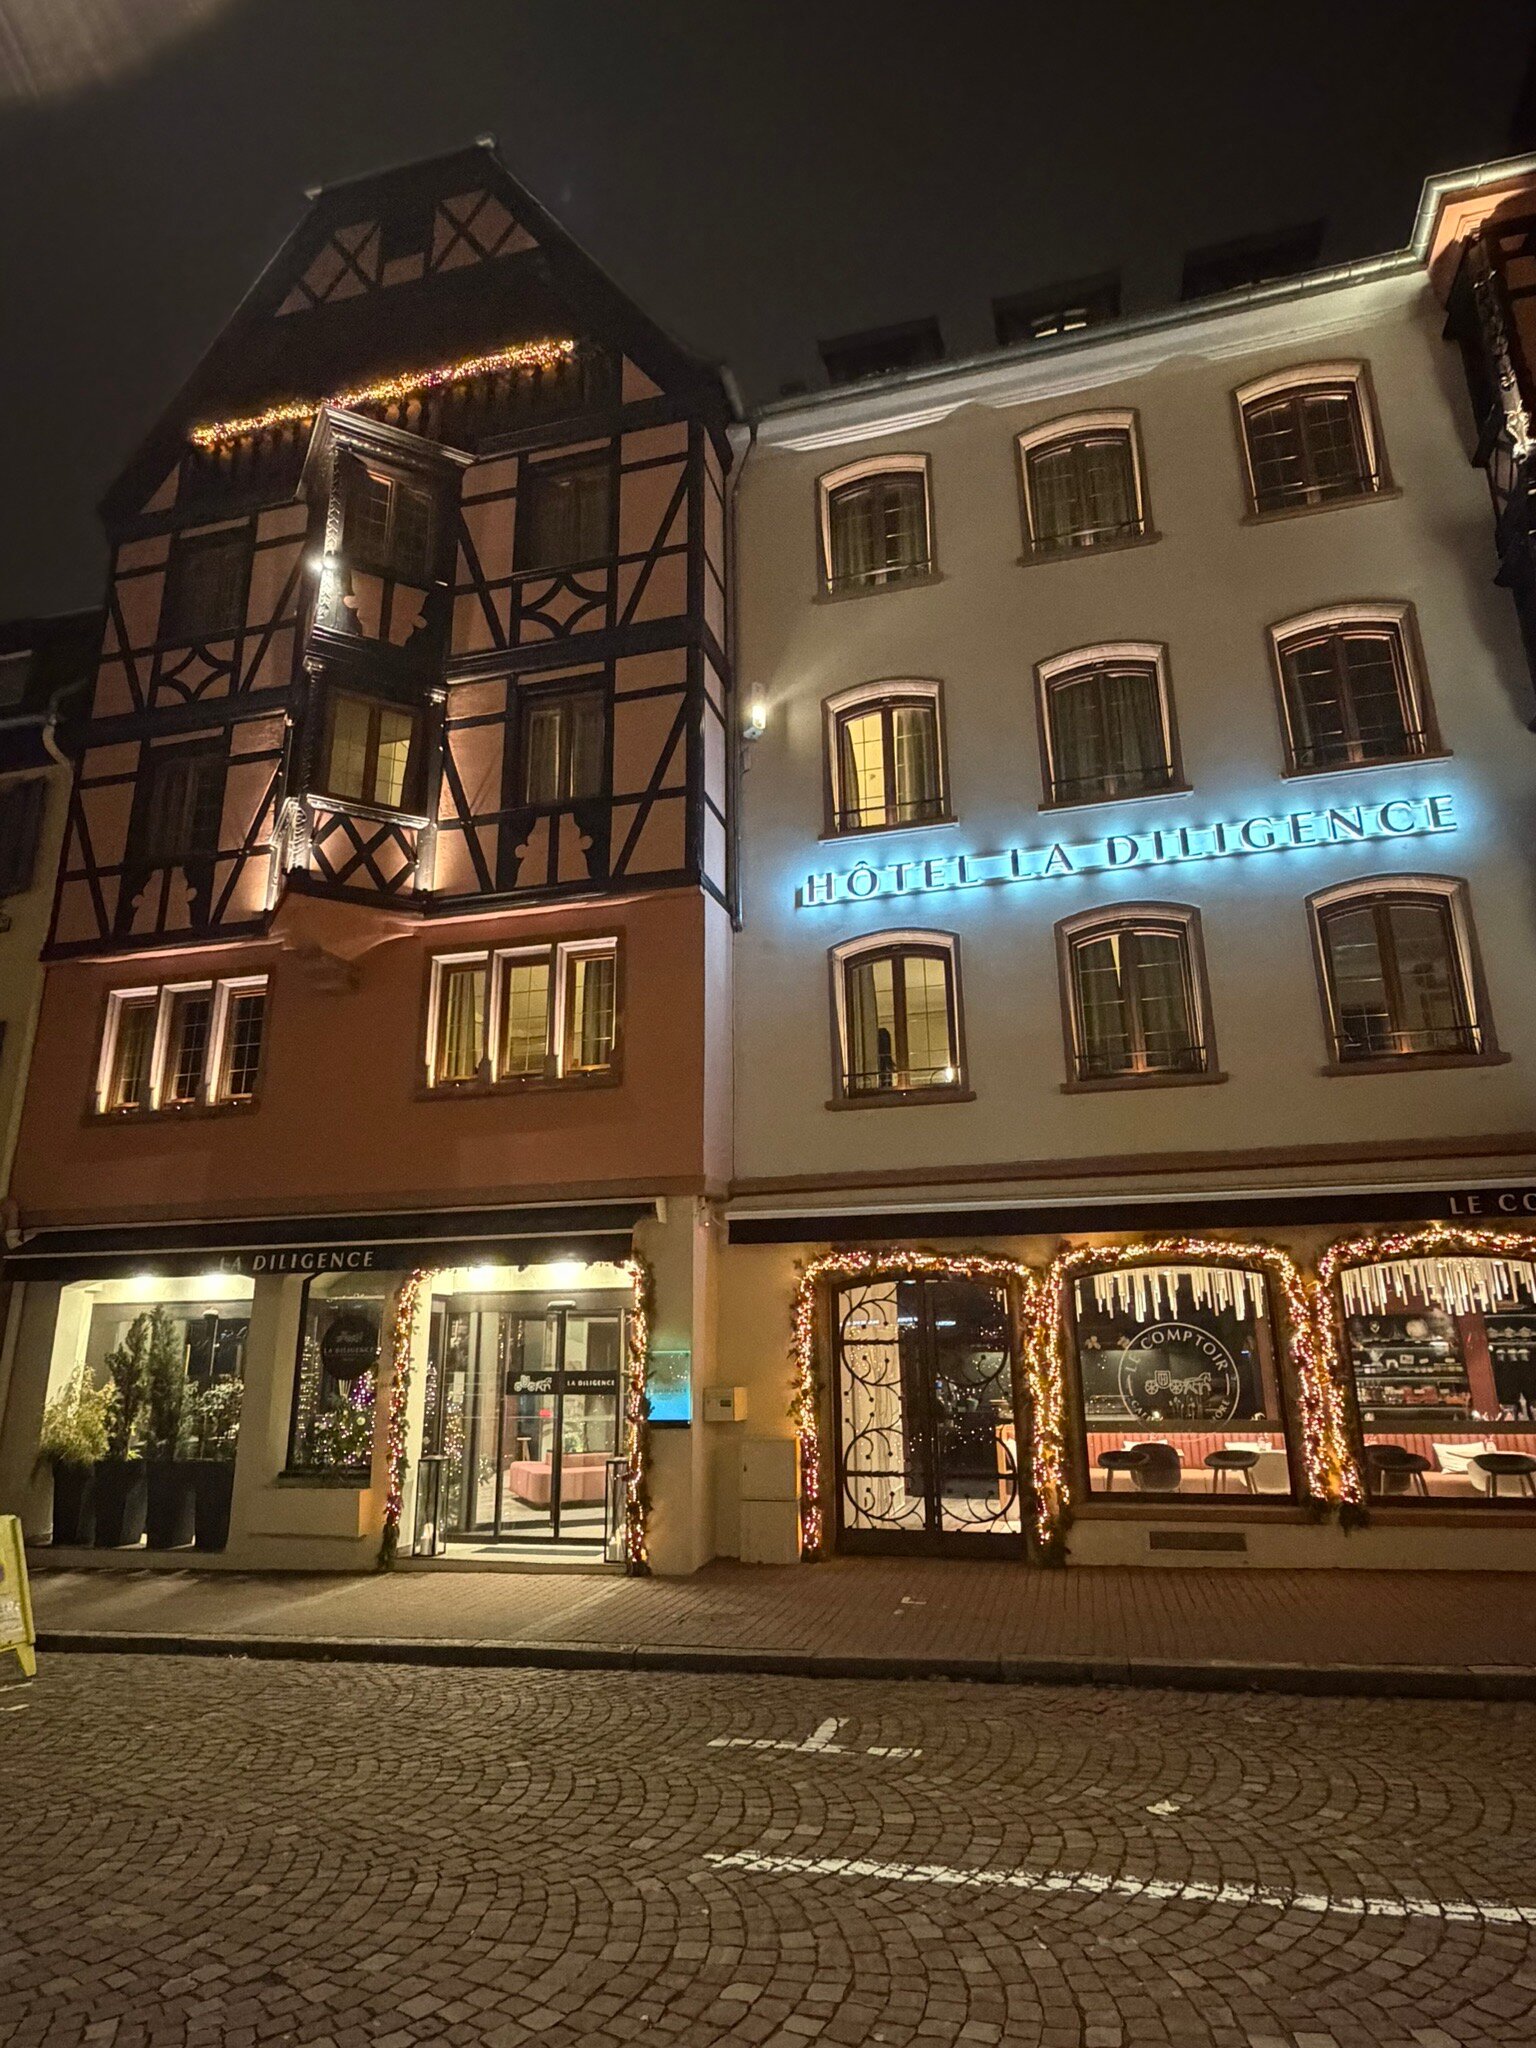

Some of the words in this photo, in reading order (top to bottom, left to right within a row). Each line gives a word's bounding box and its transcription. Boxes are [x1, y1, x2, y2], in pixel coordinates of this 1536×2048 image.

[804, 855, 981, 904] HÔTEL
[1010, 843, 1075, 880] LA
[1105, 795, 1459, 869] DILIGENCE
[1449, 1195, 1483, 1215] LE
[219, 1256, 242, 1272] LA
[252, 1251, 374, 1270] DILIGENCE
[1125, 1353, 1141, 1373] LE
[1140, 1328, 1228, 1371] COMPTOIR
